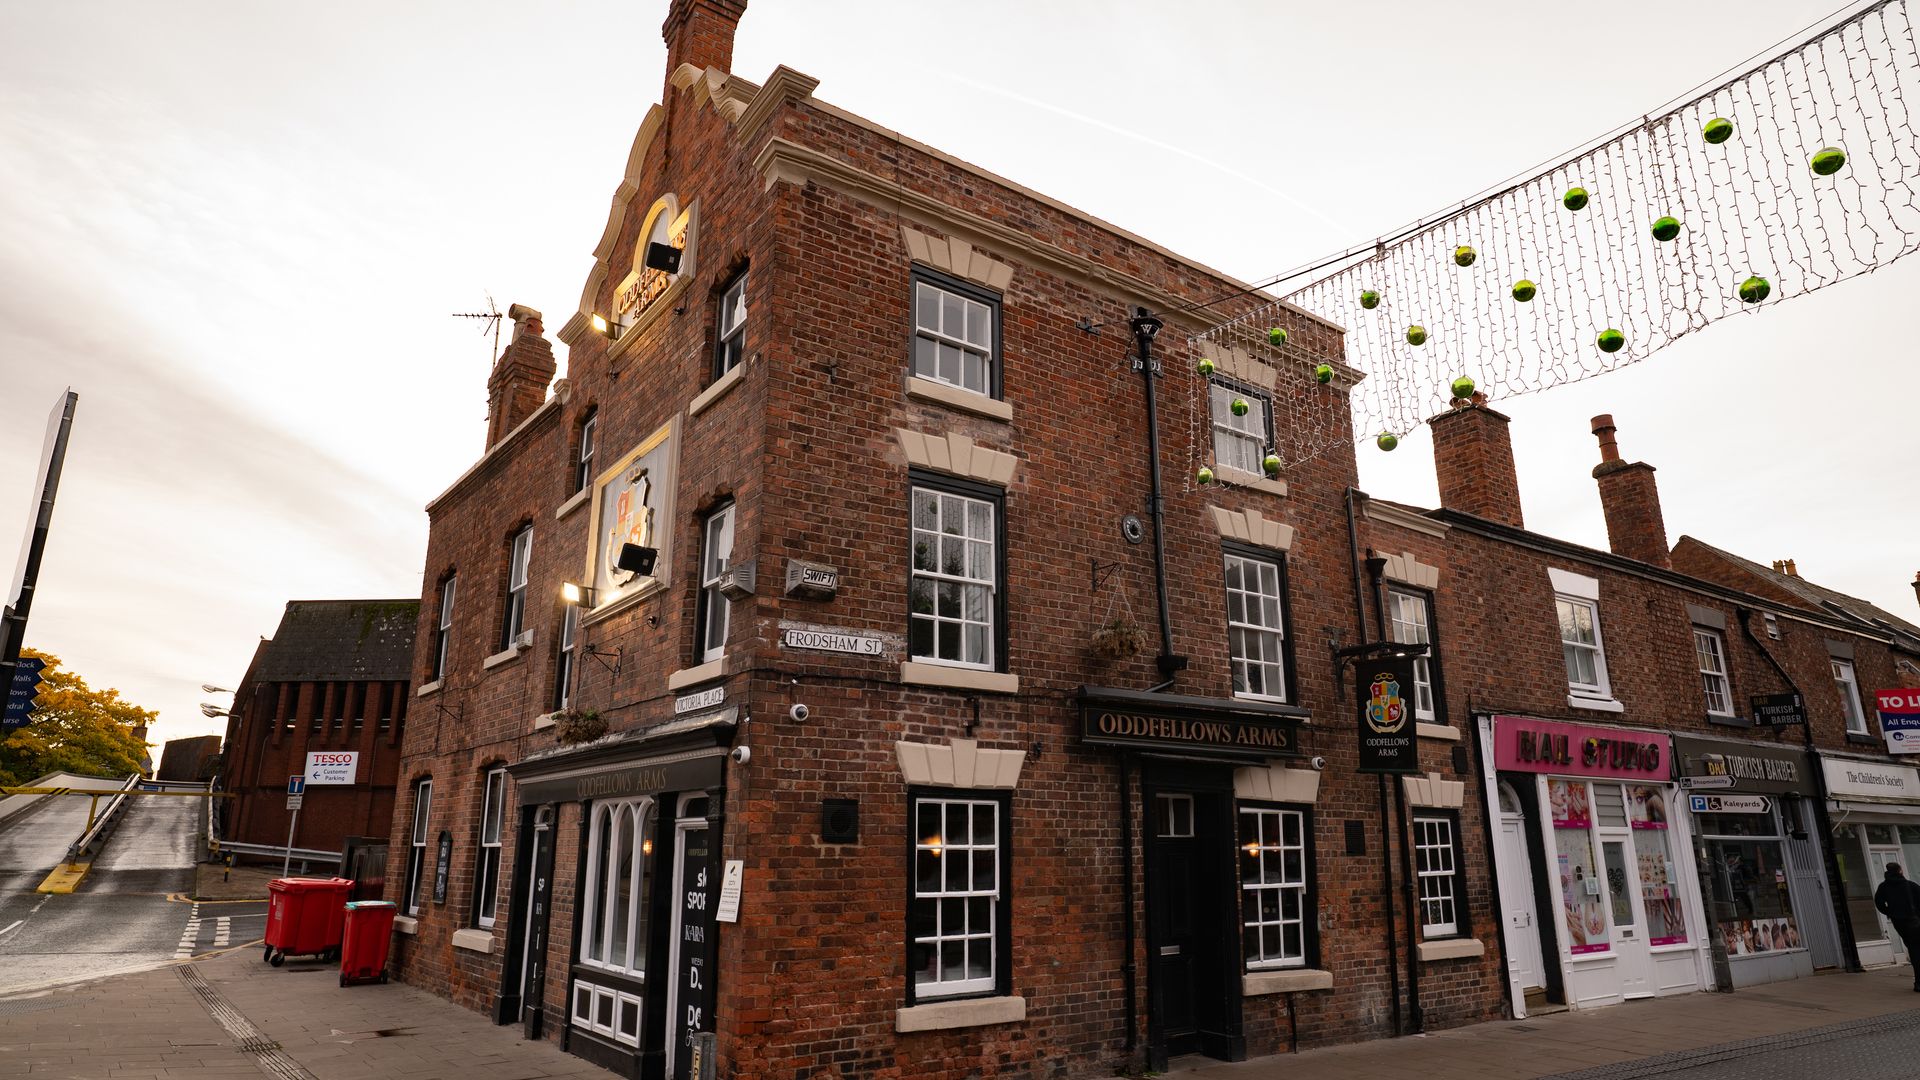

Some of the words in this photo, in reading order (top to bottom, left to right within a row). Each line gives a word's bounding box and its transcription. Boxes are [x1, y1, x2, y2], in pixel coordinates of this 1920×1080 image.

[804, 569, 834, 584] SWIFT
[789, 631, 857, 651] FRODSHAM
[865, 640, 880, 653] ST
[677, 695, 701, 712] VICTORIA
[704, 689, 723, 705] PLACE
[1879, 696, 1904, 708] TO
[1761, 705, 1794, 715] TURKISH
[1771, 714, 1802, 724] BARBER
[1888, 718, 1899, 726] All
[1100, 713, 1232, 743] ODDFELLOWS
[1236, 726, 1287, 747] ARMS
[1366, 738, 1409, 747] ODDFELLOWS
[314, 754, 352, 763] TESCO
[1517, 730, 1573, 765] NAIL
[1582, 737, 1660, 772] STUDIO
[1725, 755, 1765, 779] TURKISH
[1764, 758, 1799, 782] BARBER
[577, 773, 632, 797] ODDFELLOWS
[637, 768, 667, 791] ARMS
[1846, 771, 1857, 783] The
[1858, 773, 1885, 785] Children's
[1885, 776, 1904, 789] Society
[1723, 800, 1760, 808] Kaleyards
